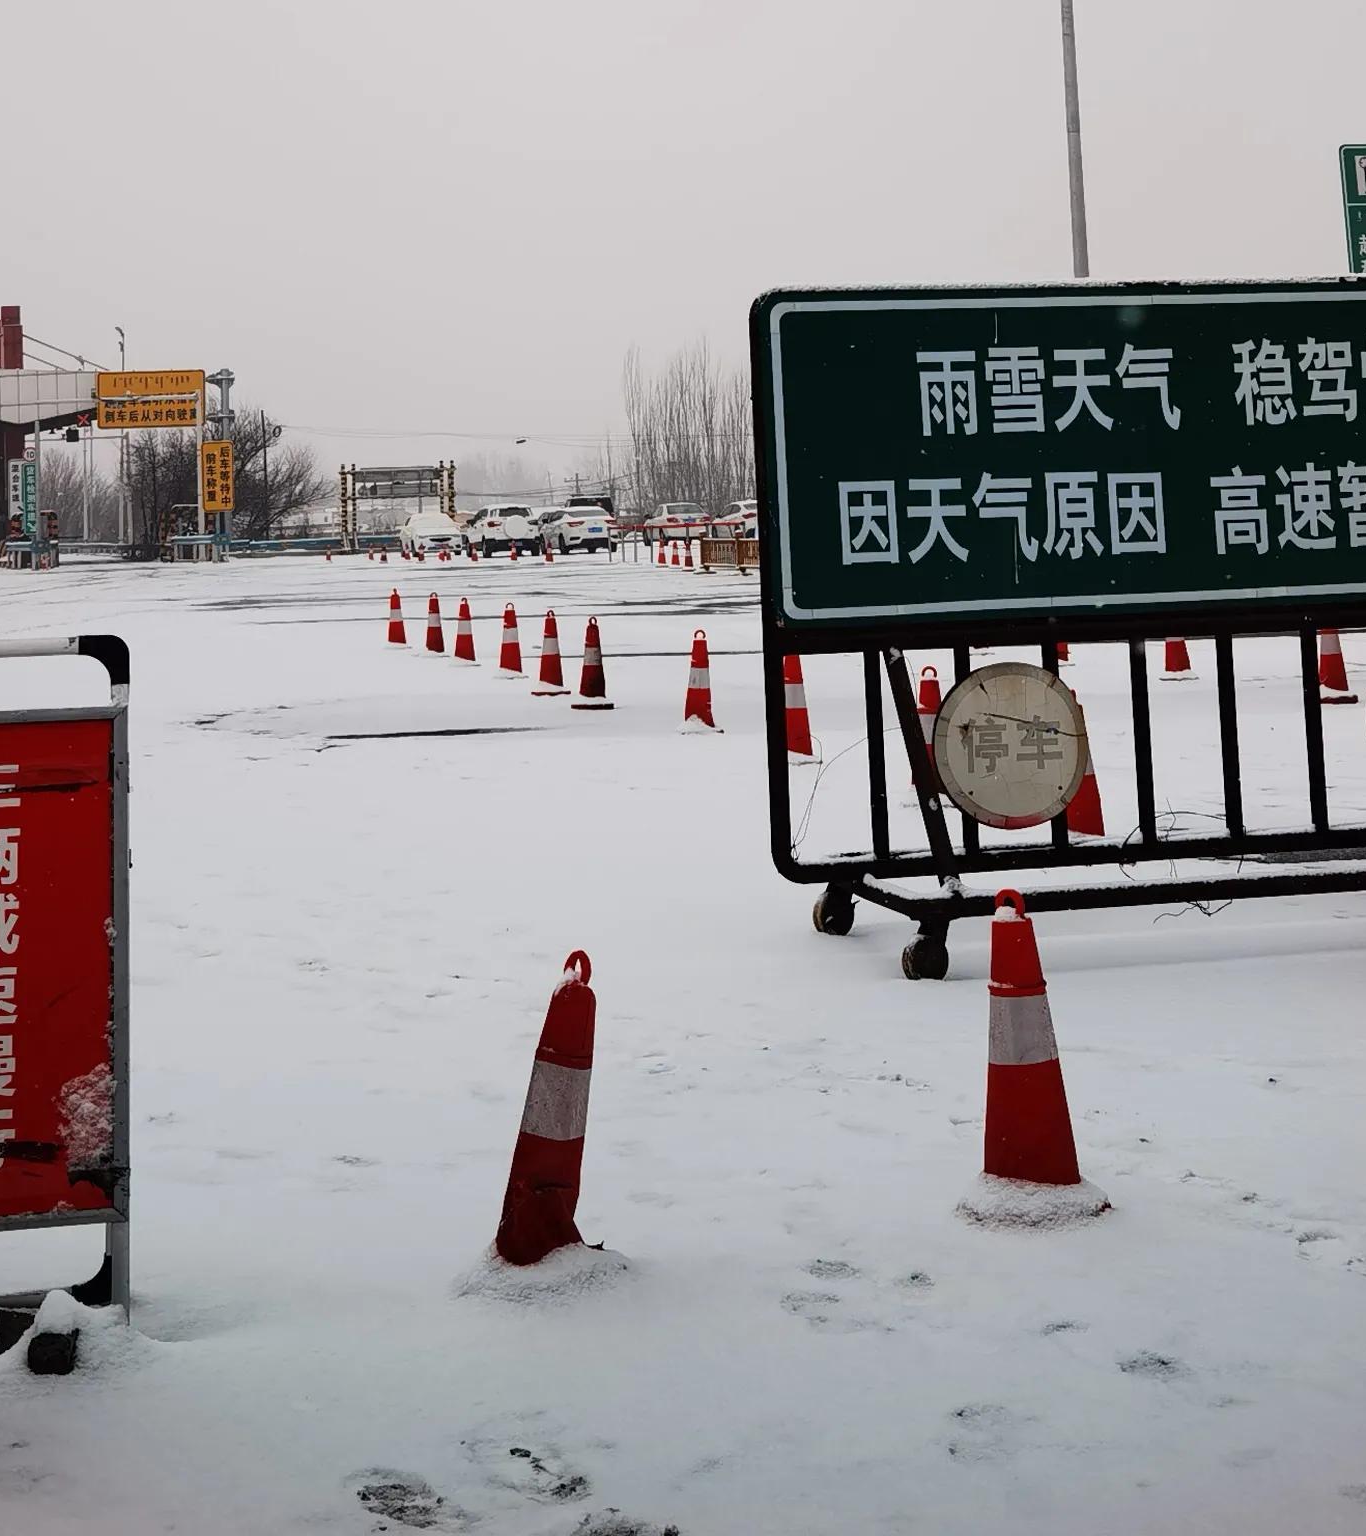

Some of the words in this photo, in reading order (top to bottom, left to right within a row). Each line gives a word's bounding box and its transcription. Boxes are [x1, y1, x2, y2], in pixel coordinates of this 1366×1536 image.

[917, 344, 1180, 437] 雨雪天气
[206, 453, 217, 502] 前车称重
[220, 446, 231, 507] 后车等待中
[837, 472, 1166, 565] 因天气原因
[961, 715, 1064, 773] 停车
